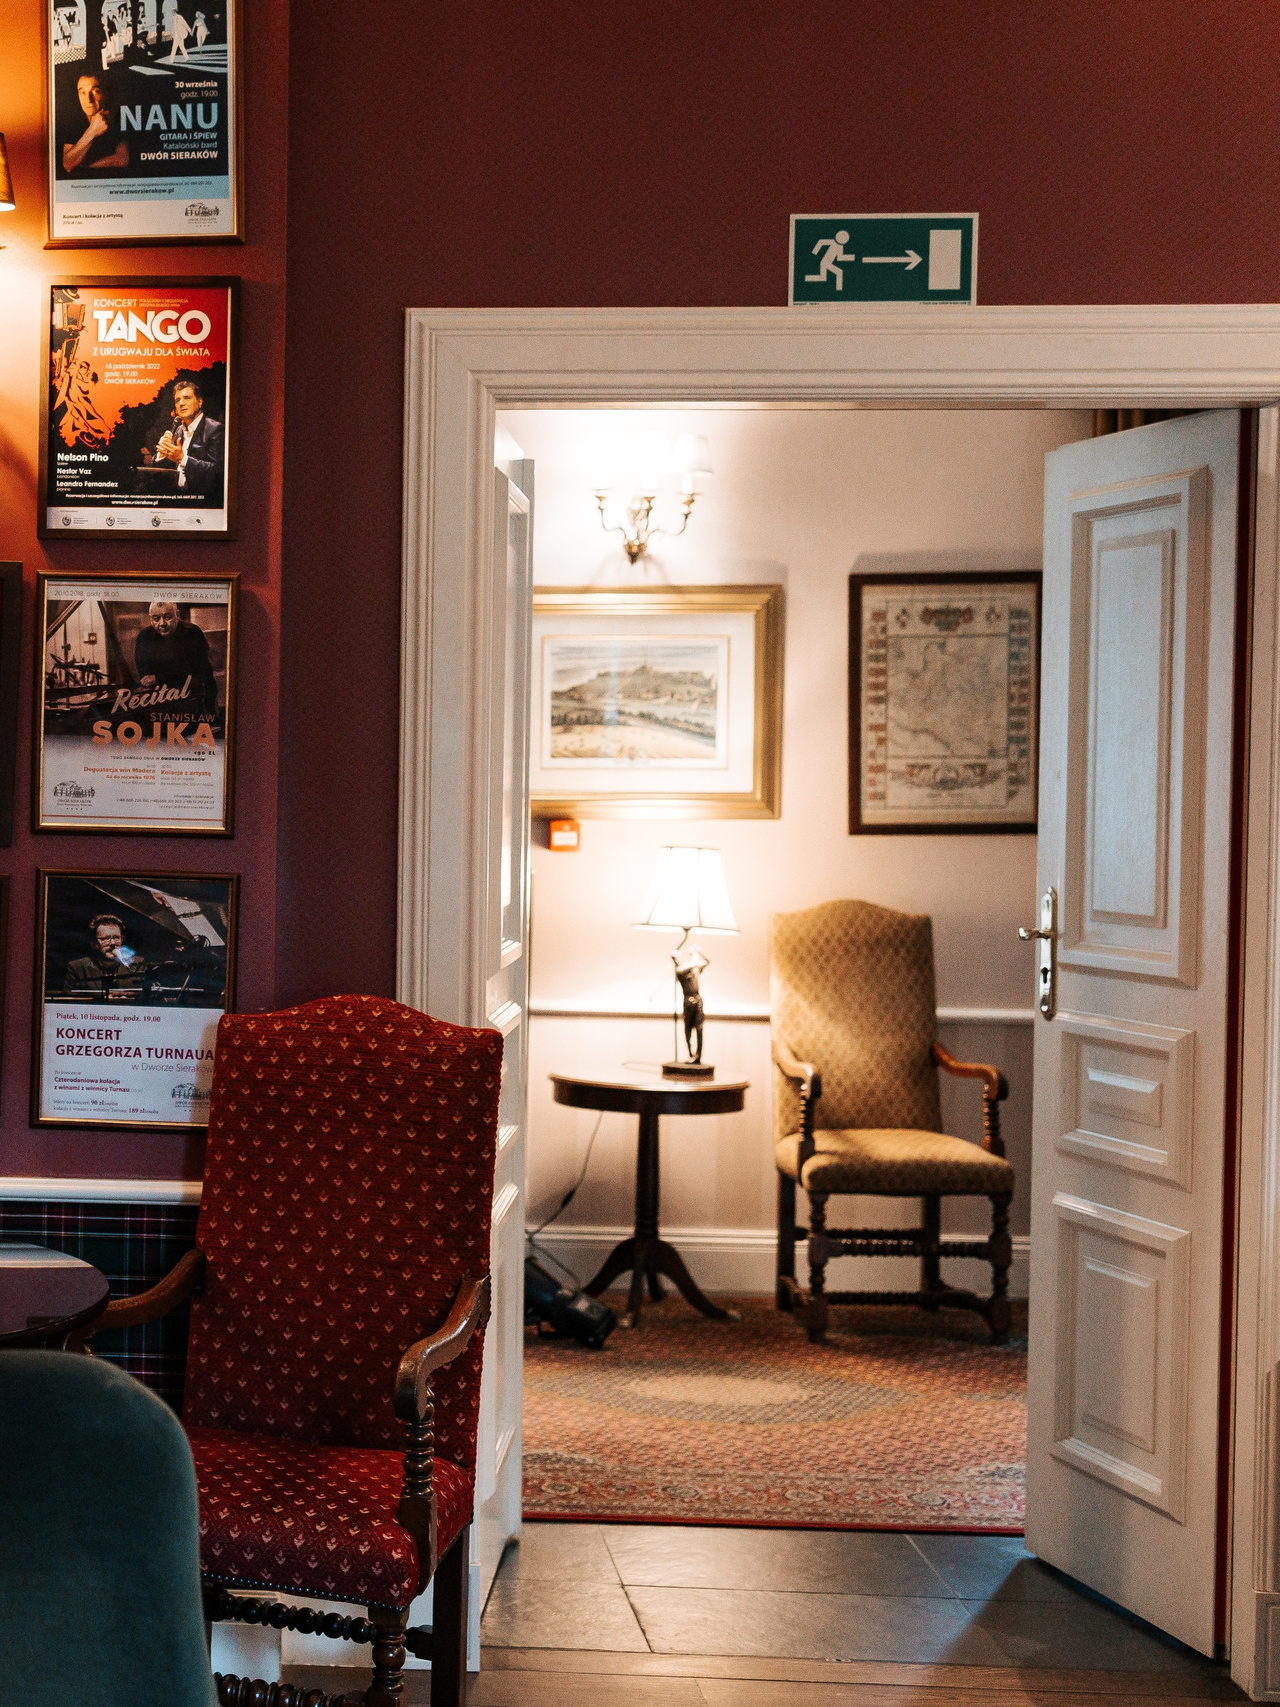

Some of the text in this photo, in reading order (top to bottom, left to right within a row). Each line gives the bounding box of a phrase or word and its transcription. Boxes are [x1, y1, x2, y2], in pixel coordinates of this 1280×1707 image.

[186, 80, 218, 88] września
[121, 103, 218, 131] NANU
[194, 132, 218, 140] ŚPIEW
[164, 142, 200, 150] Kataloński
[140, 150, 218, 160] DWÓR SIERAKÓW
[94, 298, 137, 307] KONCERT
[93, 310, 211, 344] TANGO
[100, 348, 153, 356] URUGWAJU
[156, 348, 173, 356] DLA
[176, 346, 210, 356] ŚWIATA
[57, 453, 109, 462] Nelson Pino
[111, 674, 193, 714] Recital
[150, 712, 216, 723] STANISŁAW
[92, 720, 216, 748] SOJKA
[90, 1014, 121, 1022] listopada,
[56, 1028, 122, 1040] KONCERT
[56, 1044, 214, 1060] GRZEGORZA TURNAUA
[141, 1062, 174, 1072] Dworze
